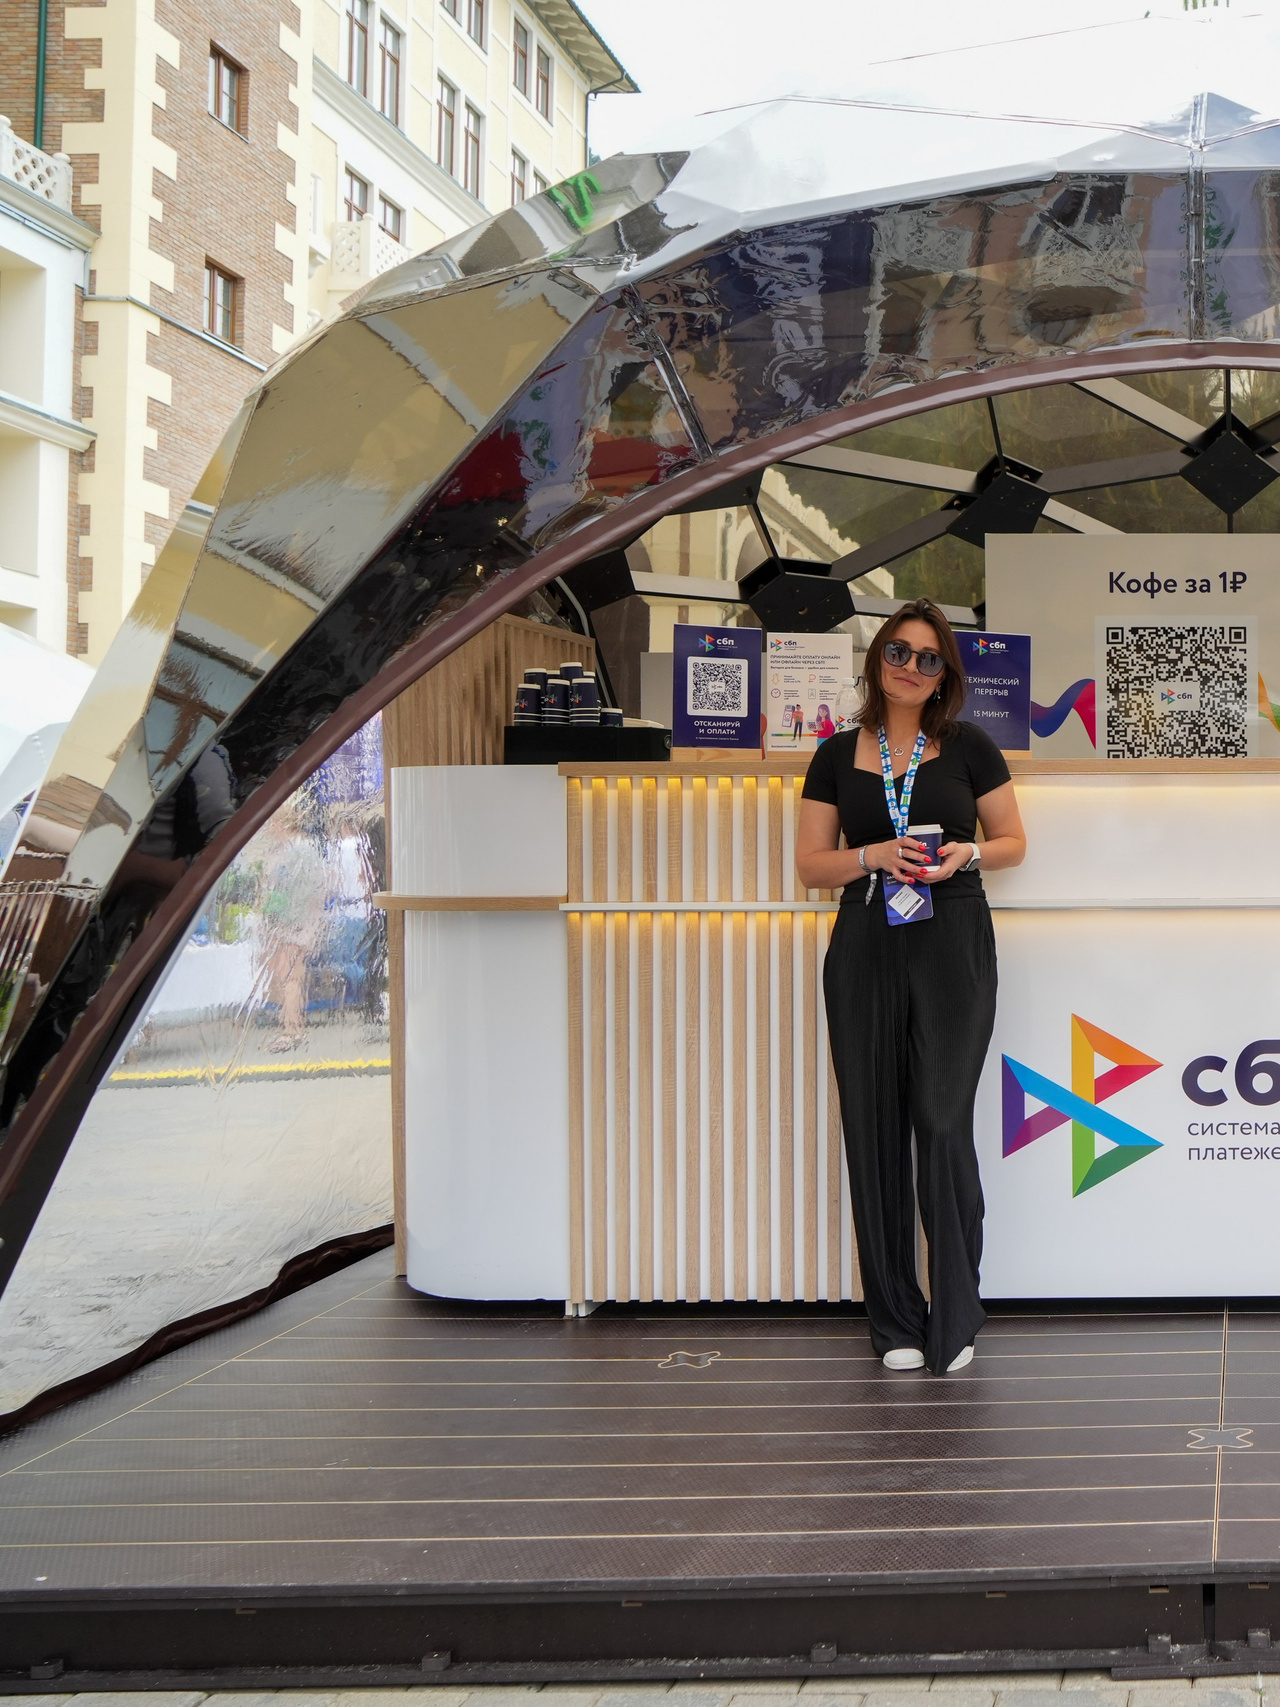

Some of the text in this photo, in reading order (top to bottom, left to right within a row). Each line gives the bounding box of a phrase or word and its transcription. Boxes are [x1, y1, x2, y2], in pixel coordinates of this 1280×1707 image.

[1109, 571, 1247, 599] Кофе за 1₽
[716, 637, 735, 645] сбп
[989, 641, 1006, 649] сбп
[974, 688, 1009, 696] ПЕРЕРЫВ
[1176, 692, 1193, 700] сбп
[982, 710, 1009, 718] МИНУТ
[693, 720, 741, 728] ОТСКАНИРУЙ
[1187, 1119, 1280, 1136] система
